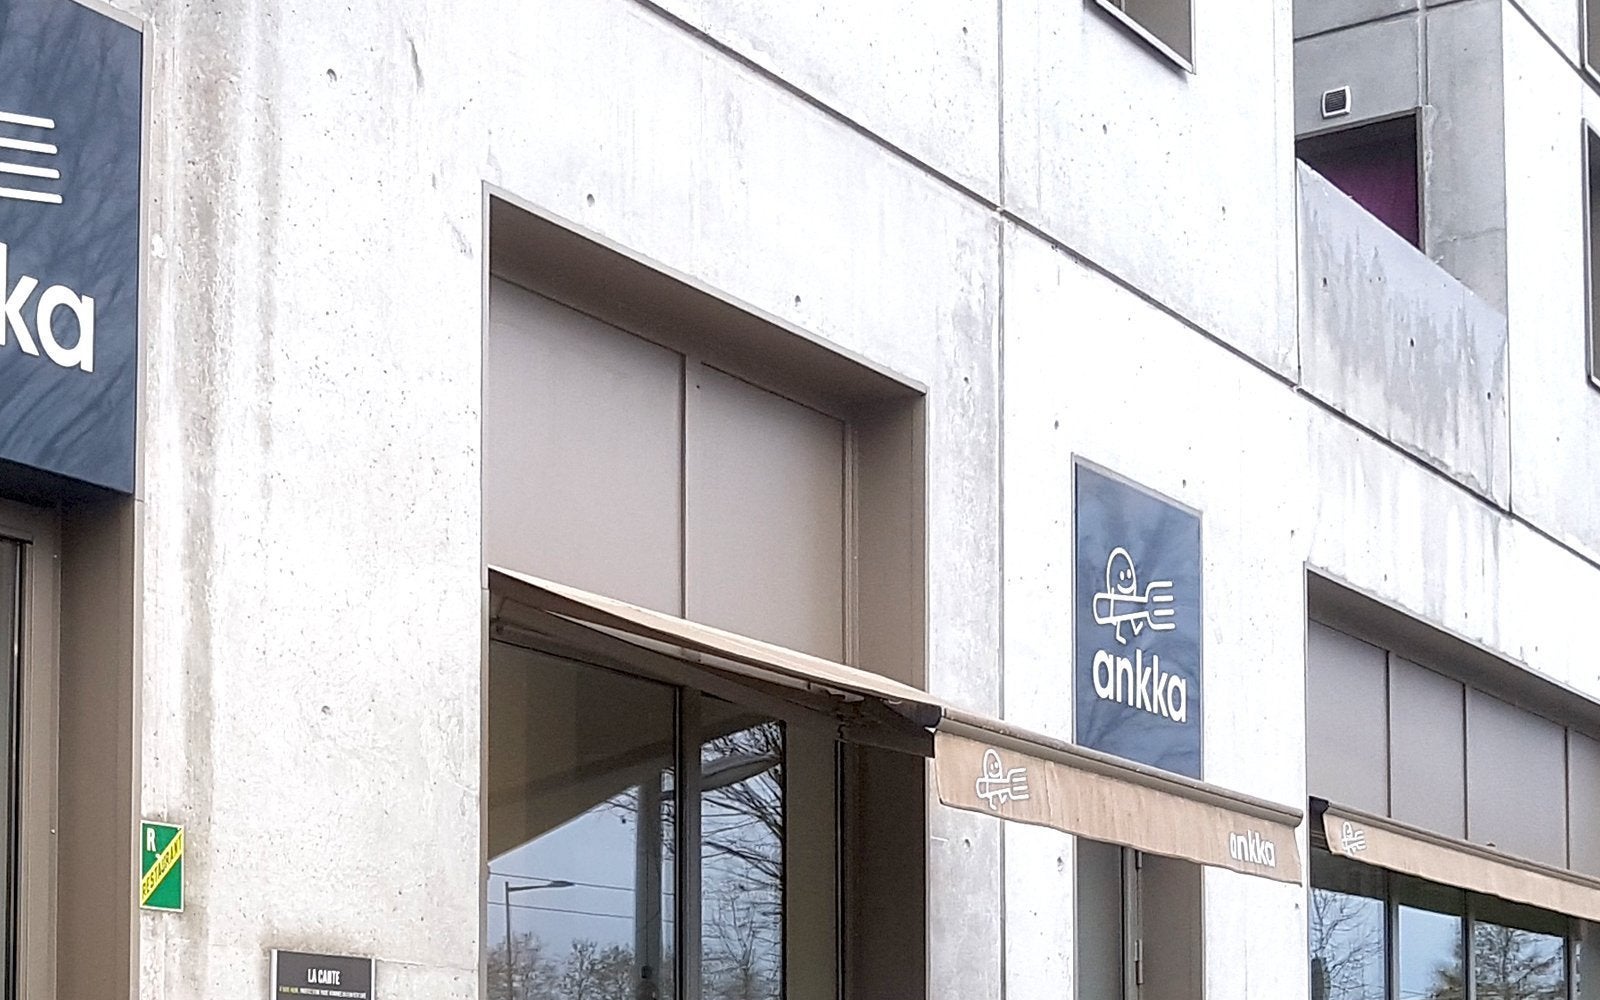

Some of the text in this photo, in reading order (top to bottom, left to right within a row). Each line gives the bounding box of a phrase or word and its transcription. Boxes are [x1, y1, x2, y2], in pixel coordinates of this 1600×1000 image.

[1092, 648, 1187, 723] ankka
[146, 827, 157, 852] R
[1229, 829, 1276, 868] ankka
[142, 832, 182, 898] RESTAURANT
[307, 968, 341, 985] LA CARTE
